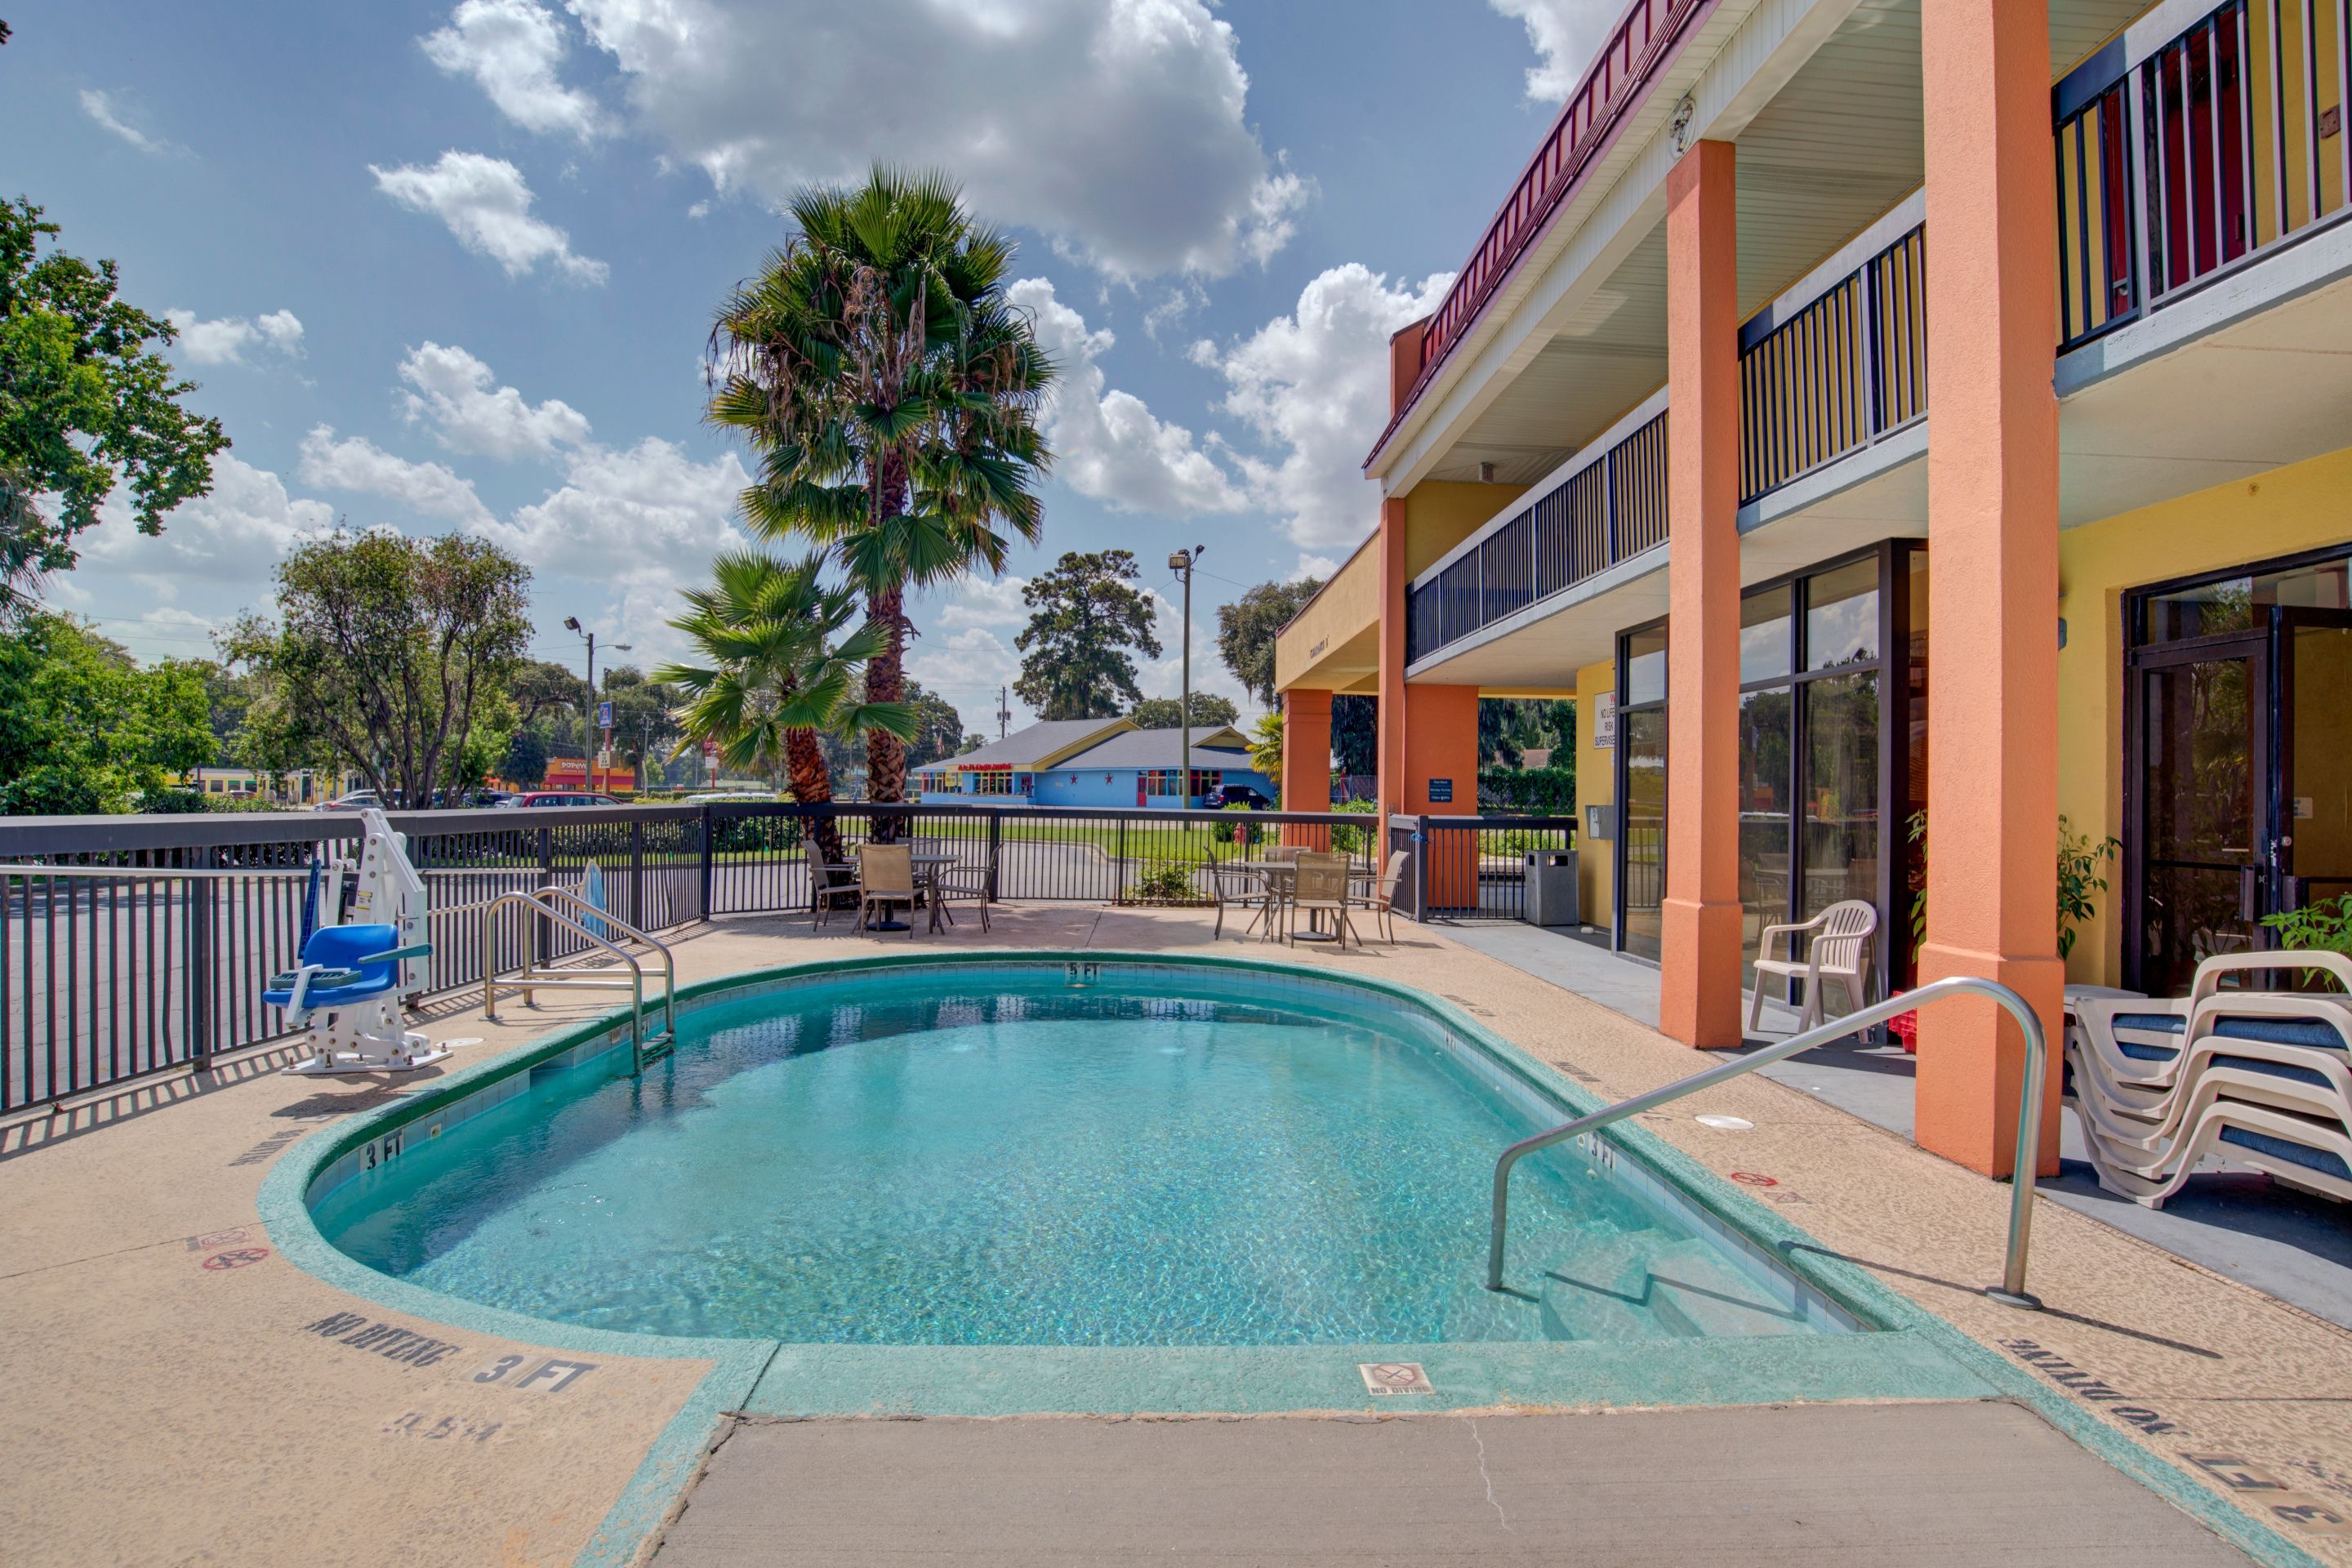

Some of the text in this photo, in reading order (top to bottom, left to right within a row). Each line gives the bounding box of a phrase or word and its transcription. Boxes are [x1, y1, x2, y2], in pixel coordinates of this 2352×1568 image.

[1605, 721, 1614, 732] RISK
[366, 1129, 403, 1169] 3 FT
[474, 1355, 601, 1392] 3 FT
